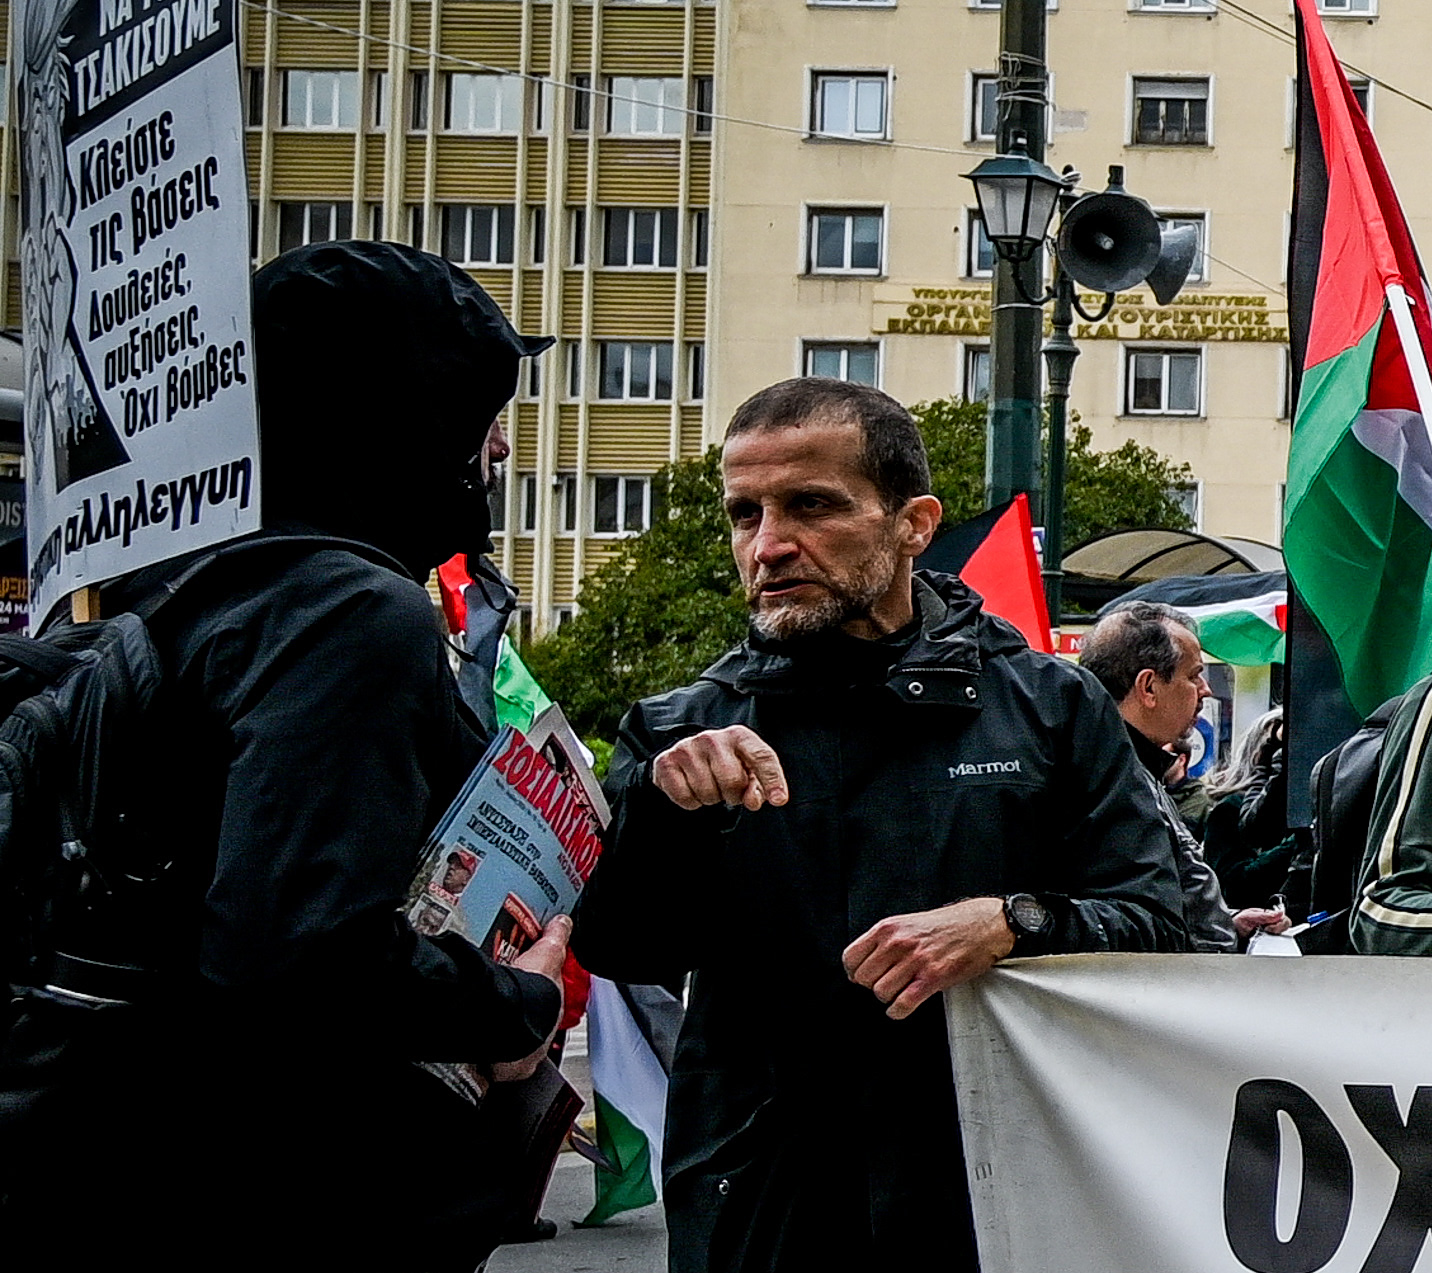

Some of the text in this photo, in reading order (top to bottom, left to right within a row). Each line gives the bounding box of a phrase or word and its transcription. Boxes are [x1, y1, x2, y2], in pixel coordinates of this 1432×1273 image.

[79, 110, 175, 211] Κλείστε
[89, 156, 220, 272] τις βάσεις
[89, 247, 191, 342] Δουλειές,
[888, 319, 991, 335] ΕΚΠΑΙΔΕ
[907, 304, 991, 319] ΟΡΓΑΝ
[913, 288, 991, 300] ΥΠΟΥΡΓΕ
[1078, 324, 1118, 338] ΚΑΙ
[104, 304, 205, 390] αυξήσεις,
[120, 340, 247, 439] Όχι βόμβες
[64, 456, 252, 555] αλληλεγγυη
[492, 728, 603, 883] ΣΟΣΙΑΛΙΣΜΟΣ
[949, 760, 1021, 778] Marmot
